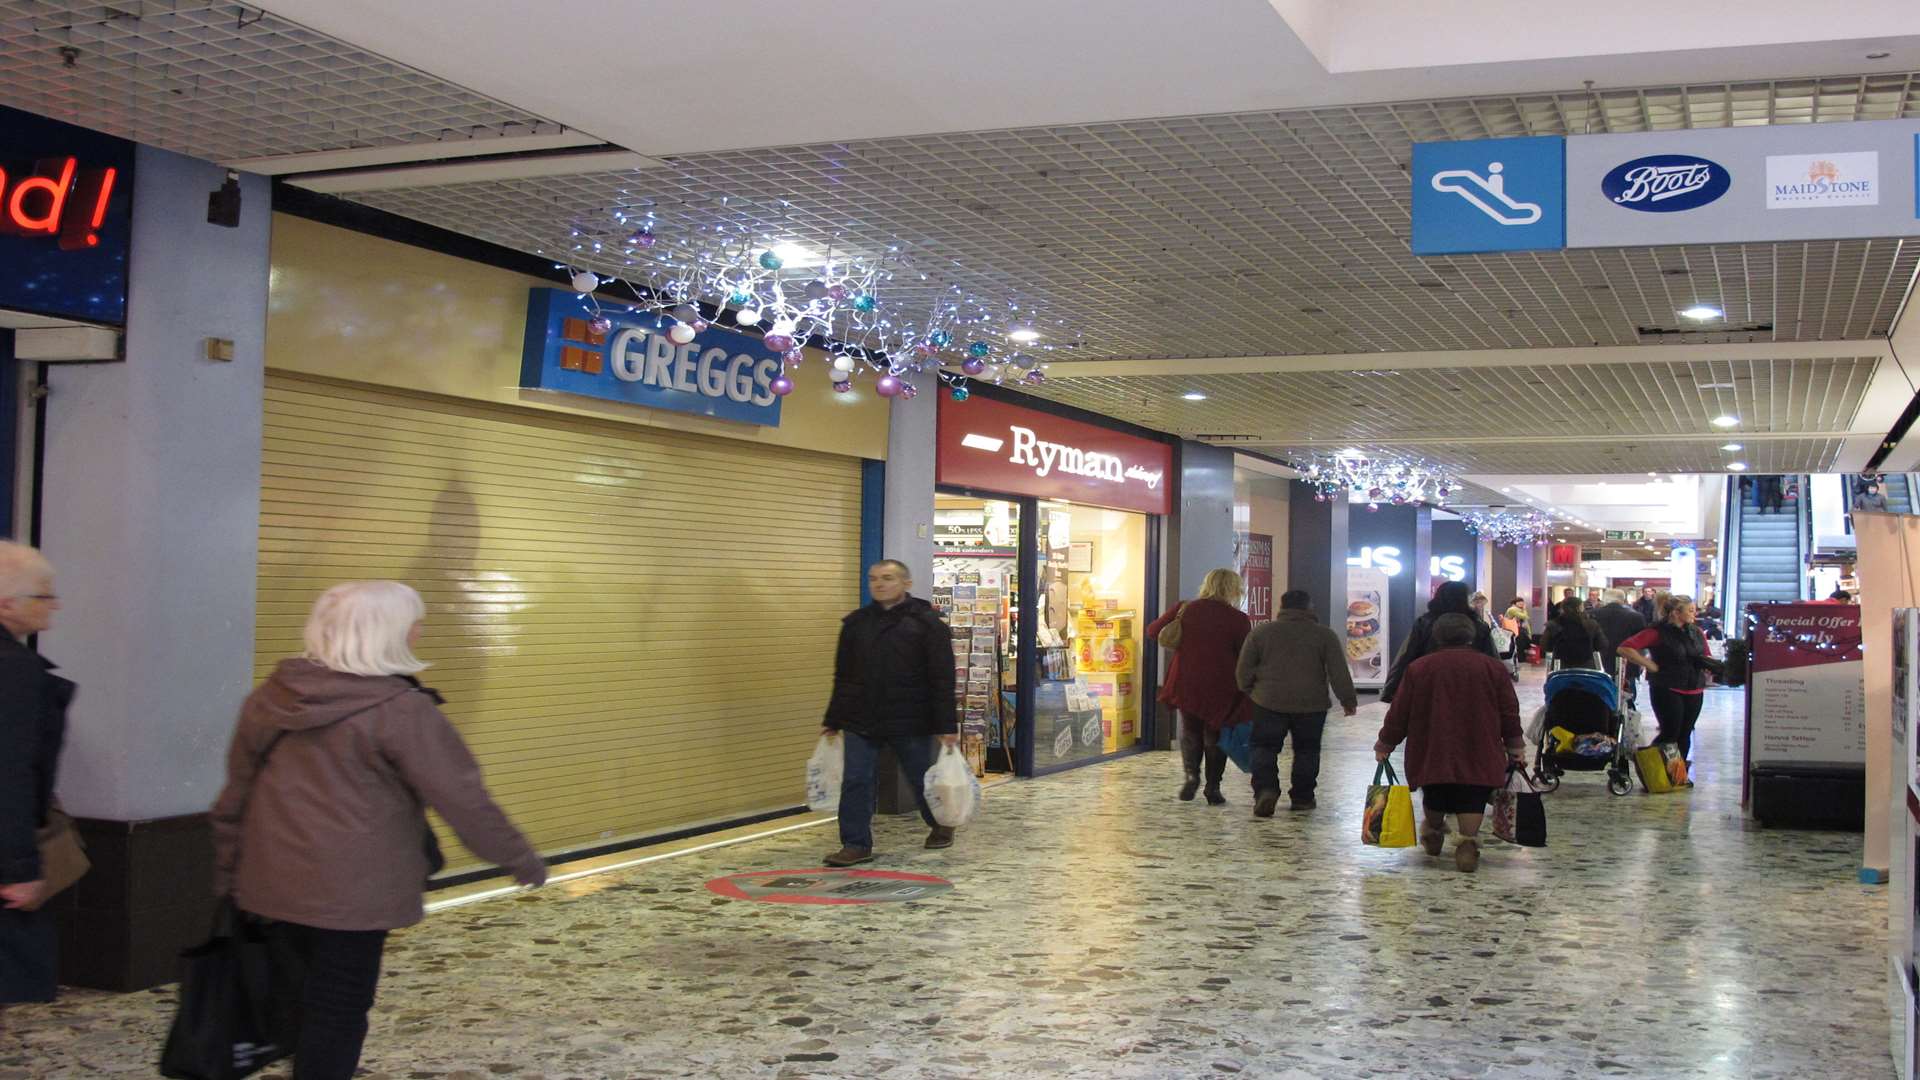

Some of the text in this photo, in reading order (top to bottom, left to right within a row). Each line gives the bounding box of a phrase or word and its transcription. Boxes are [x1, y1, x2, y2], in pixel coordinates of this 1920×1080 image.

[1614, 163, 1710, 203] Boots
[1775, 176, 1870, 195] MAIDSTONE
[610, 327, 779, 407] GREGGS
[1009, 425, 1125, 483] Ryman
[1767, 616, 1814, 628] Special
[1818, 616, 1854, 629] Offer
